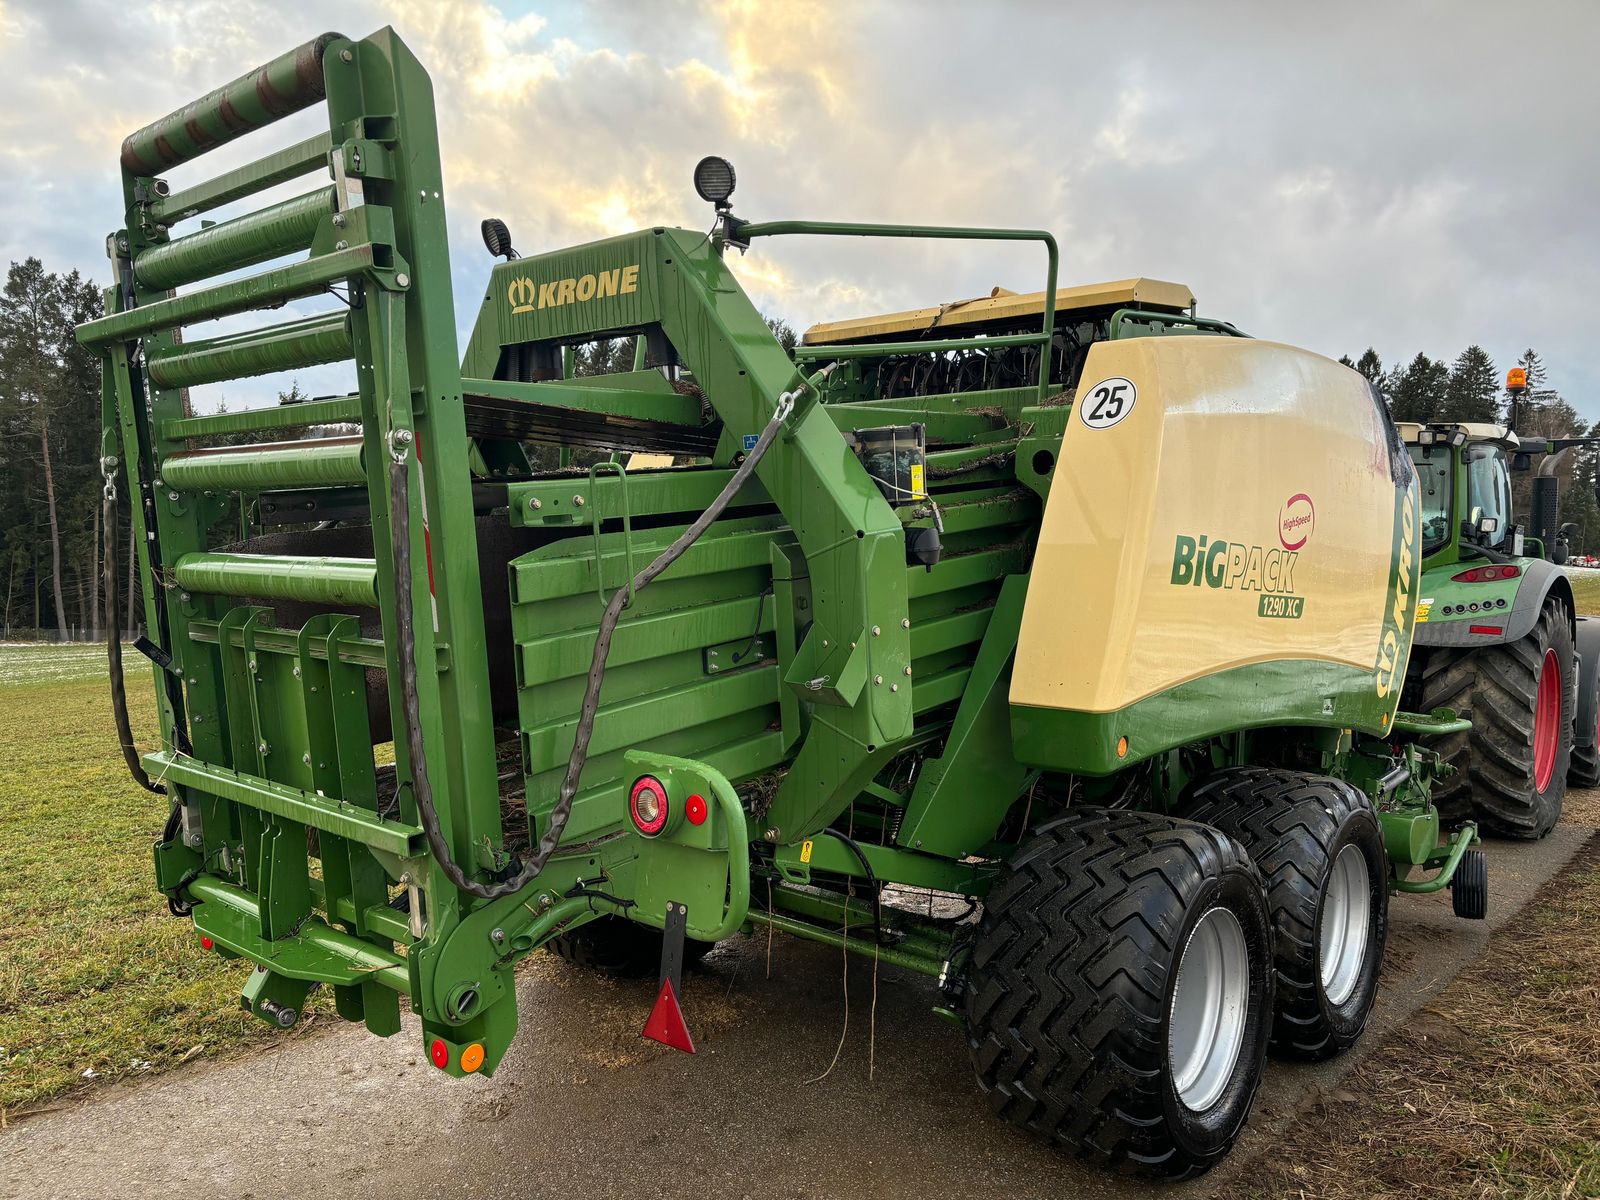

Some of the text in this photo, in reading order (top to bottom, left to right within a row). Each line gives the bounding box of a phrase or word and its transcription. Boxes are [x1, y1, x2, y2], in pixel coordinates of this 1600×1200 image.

[537, 264, 640, 309] KRONE
[1088, 385, 1128, 420] 25
[1283, 512, 1311, 531] HighSpeed
[1393, 486, 1414, 634] KRO
[1263, 597, 1300, 617] 1290 XC
